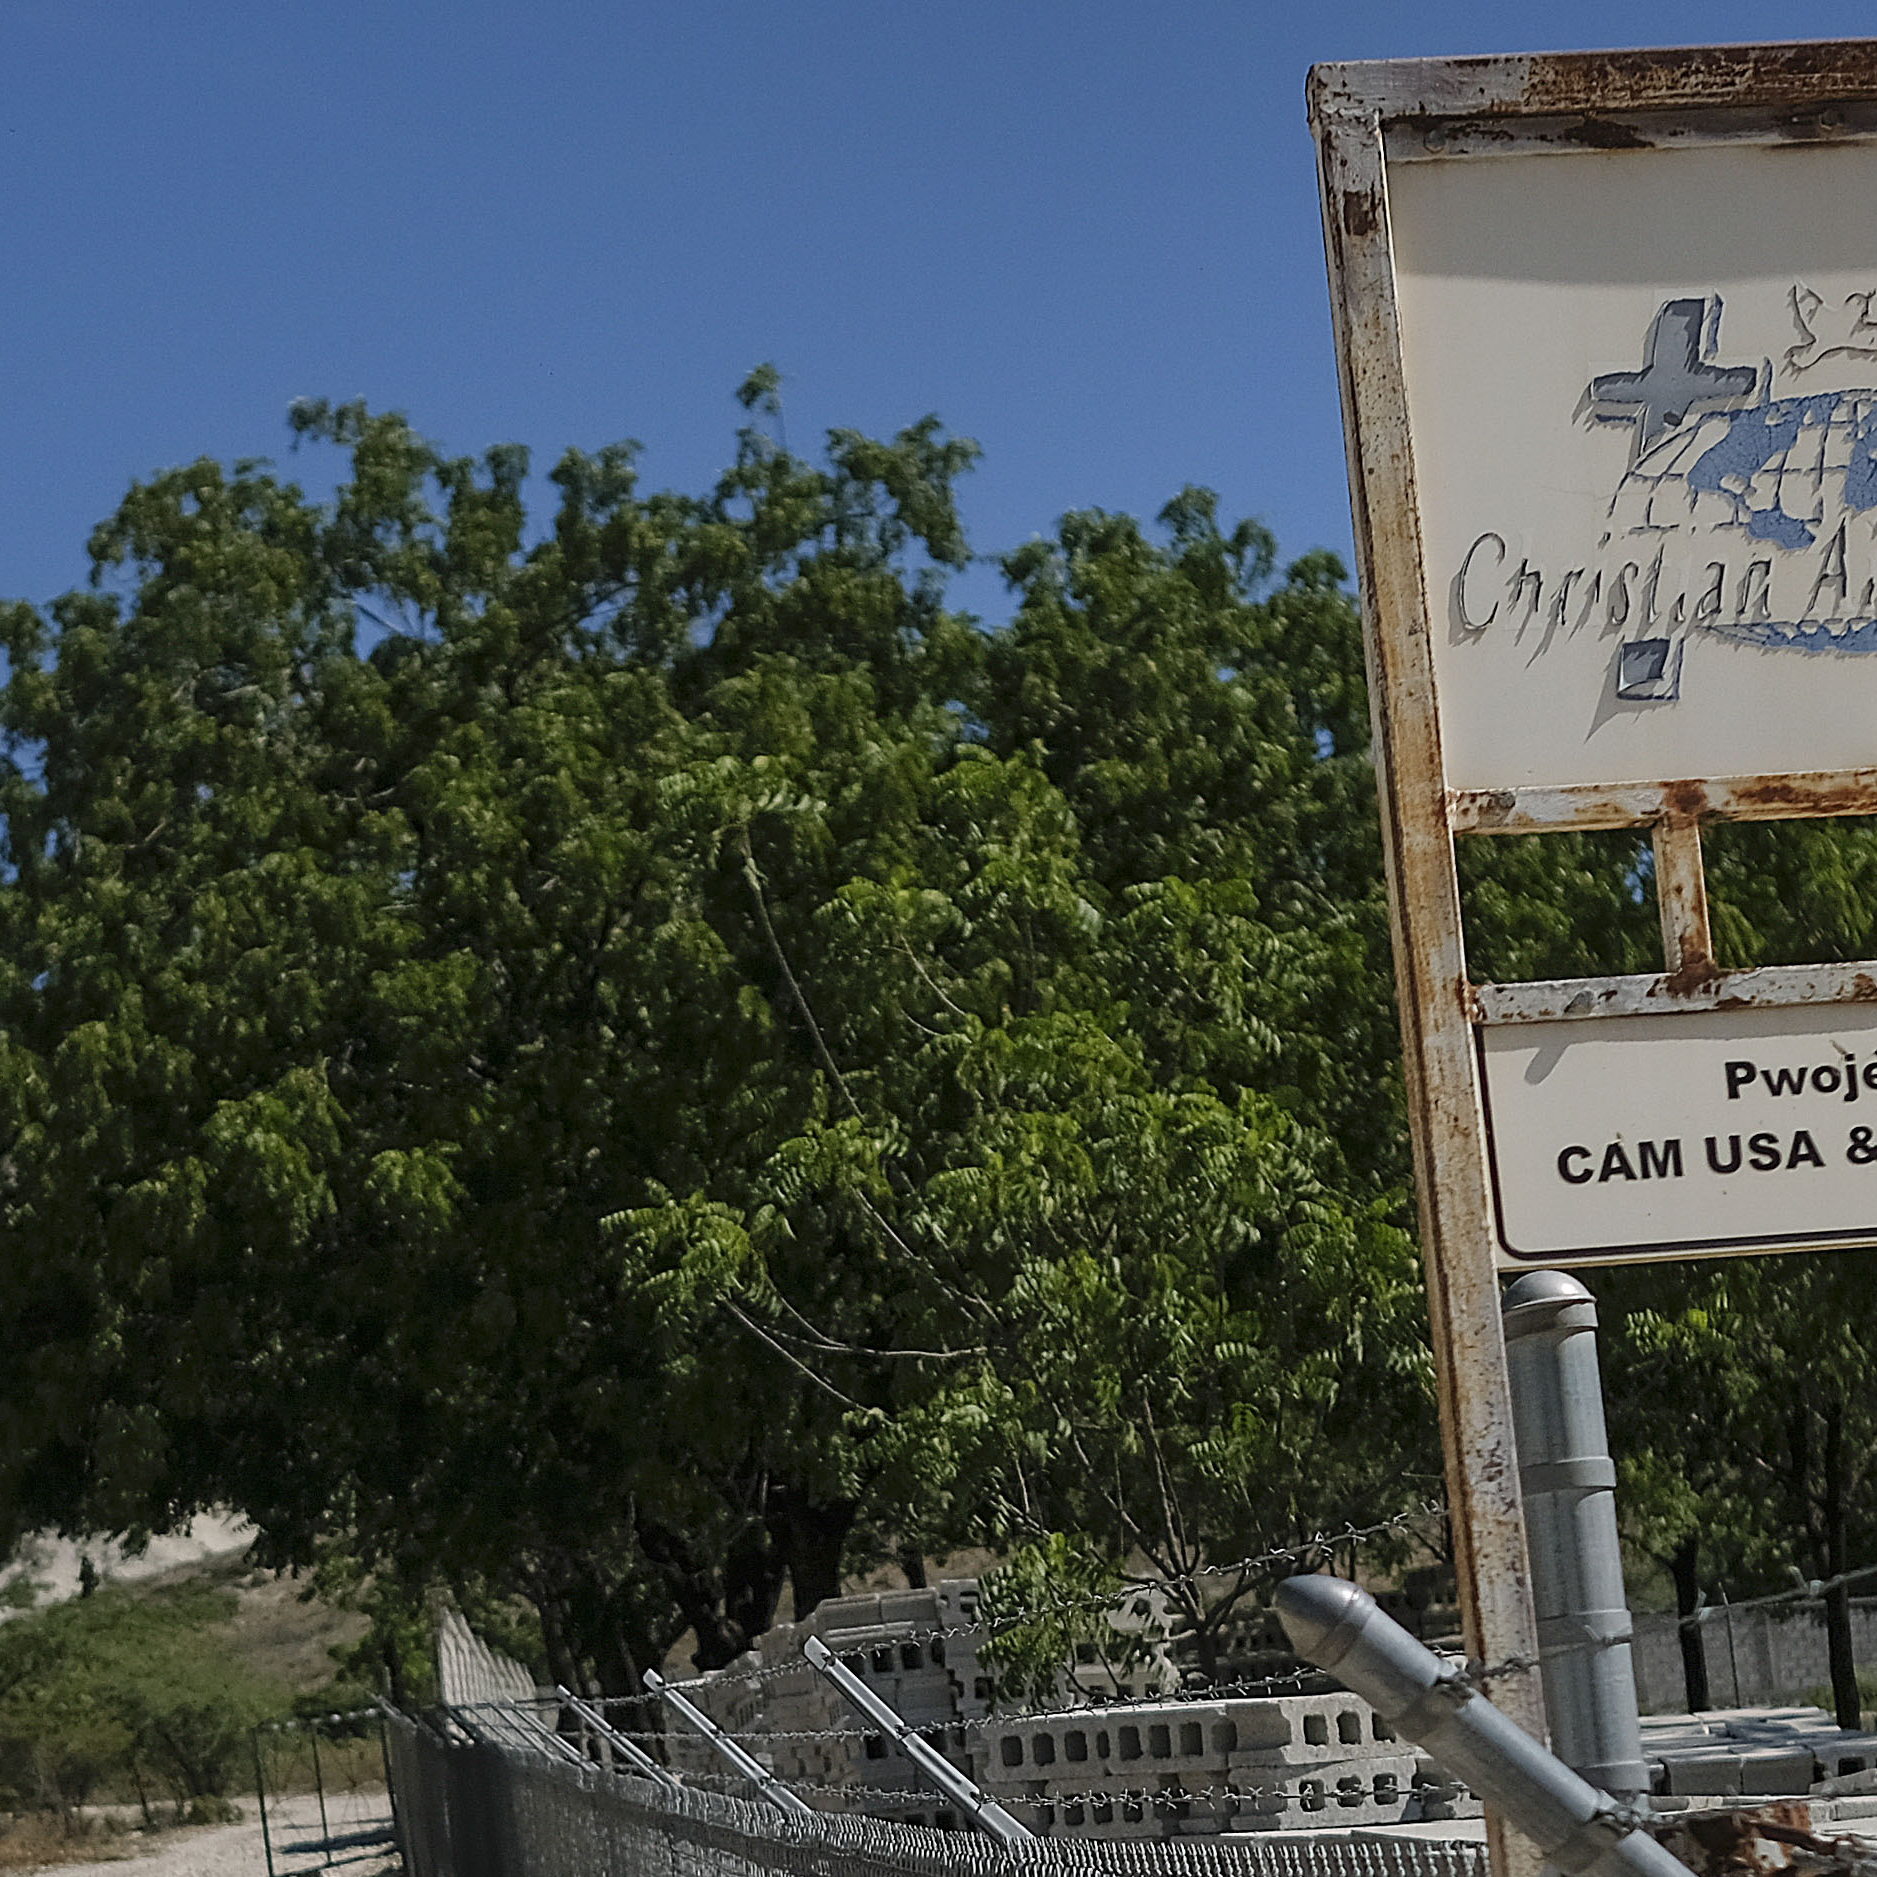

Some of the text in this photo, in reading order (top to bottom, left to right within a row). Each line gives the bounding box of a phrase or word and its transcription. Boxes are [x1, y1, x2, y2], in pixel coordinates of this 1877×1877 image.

[1458, 531, 1773, 630] Christian
[1557, 1139, 1685, 1184] CAM
[1704, 1130, 1826, 1174] USA
